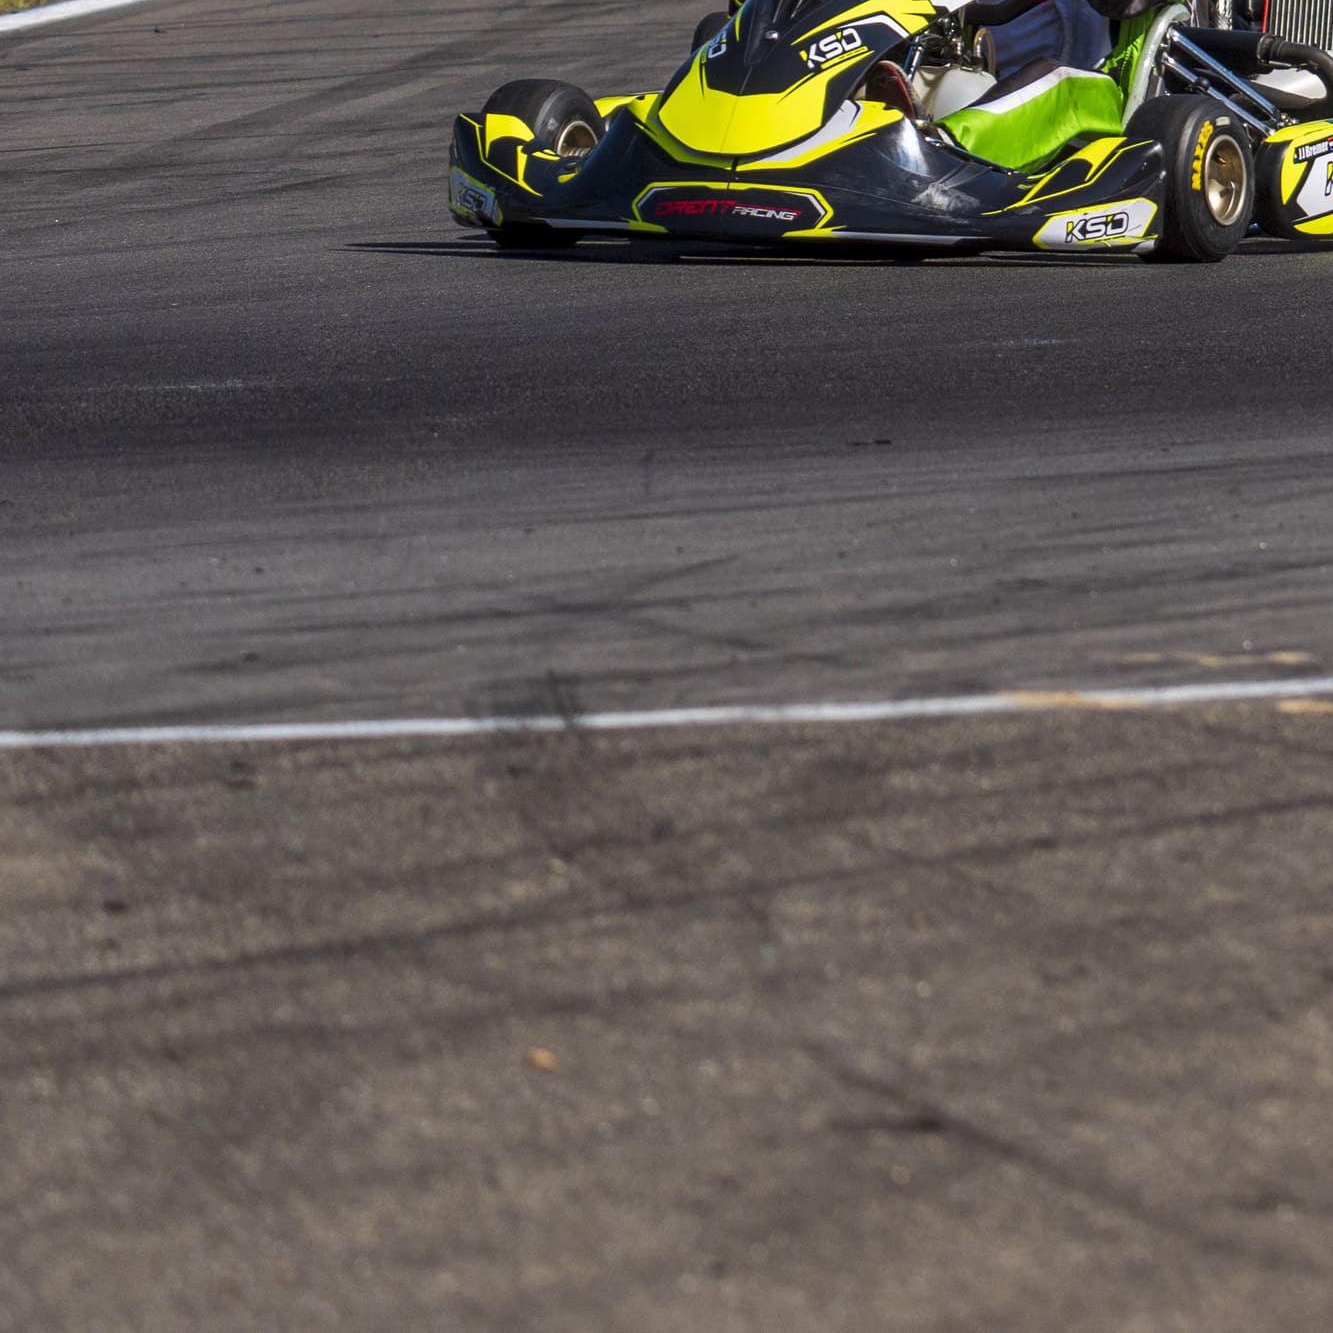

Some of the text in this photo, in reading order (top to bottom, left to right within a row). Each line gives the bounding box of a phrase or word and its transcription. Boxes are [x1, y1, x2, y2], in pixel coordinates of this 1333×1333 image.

[800, 27, 864, 70] KSD
[731, 206, 798, 221] RACING
[1065, 211, 1130, 244] KSD
